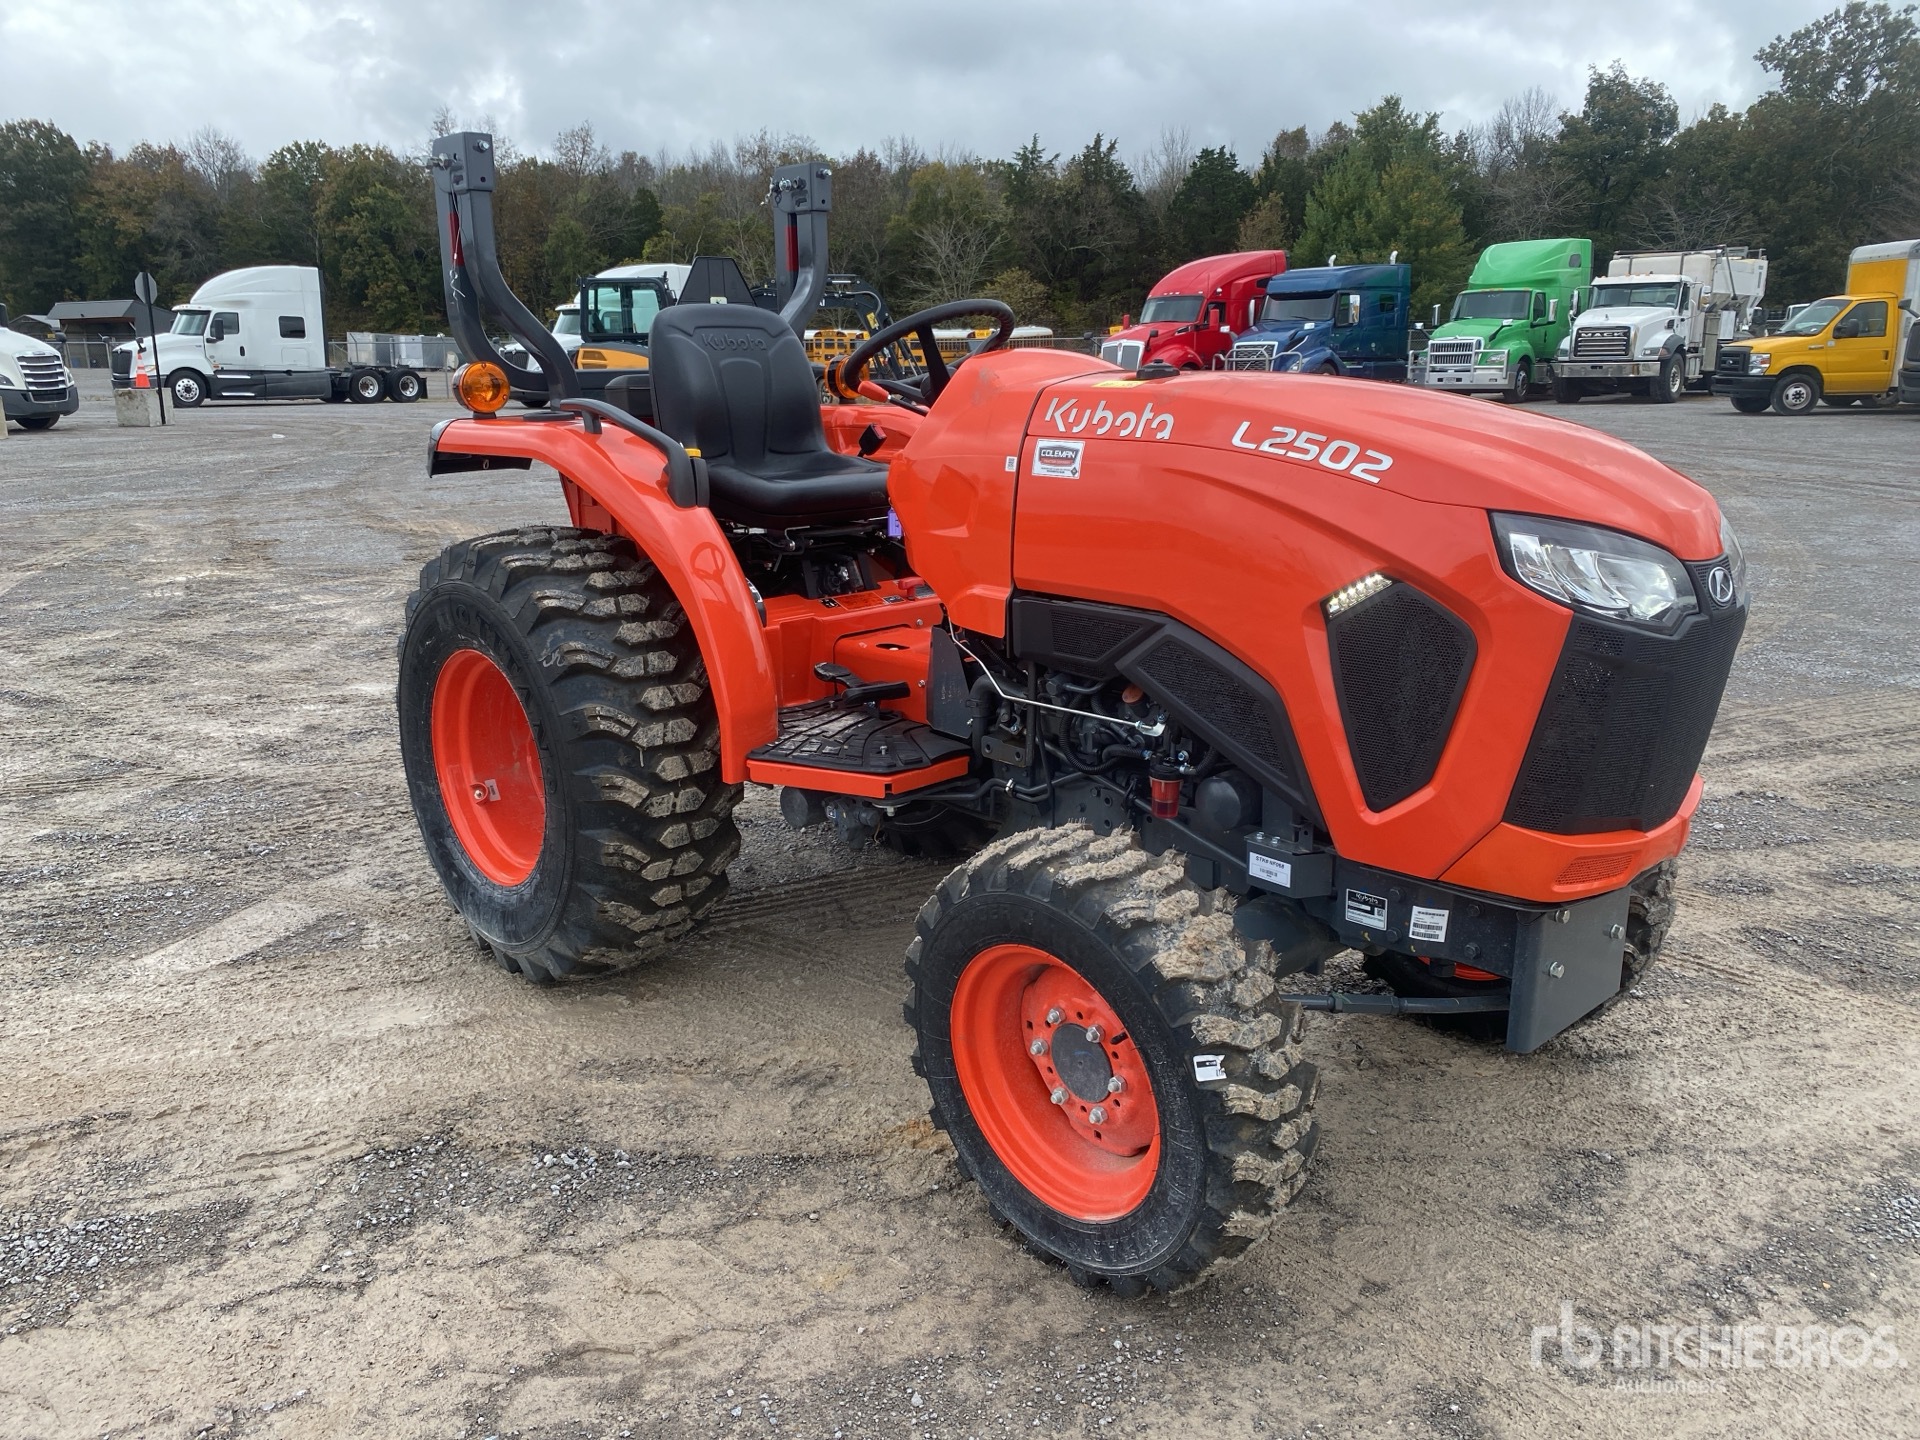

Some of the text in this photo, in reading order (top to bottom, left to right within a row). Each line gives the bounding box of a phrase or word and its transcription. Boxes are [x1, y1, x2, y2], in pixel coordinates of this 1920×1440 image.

[702, 333, 767, 351] Kubota
[1044, 397, 1175, 440] Kubota
[1040, 449, 1076, 459] COLEMAN
[1231, 421, 1394, 484] L2502
